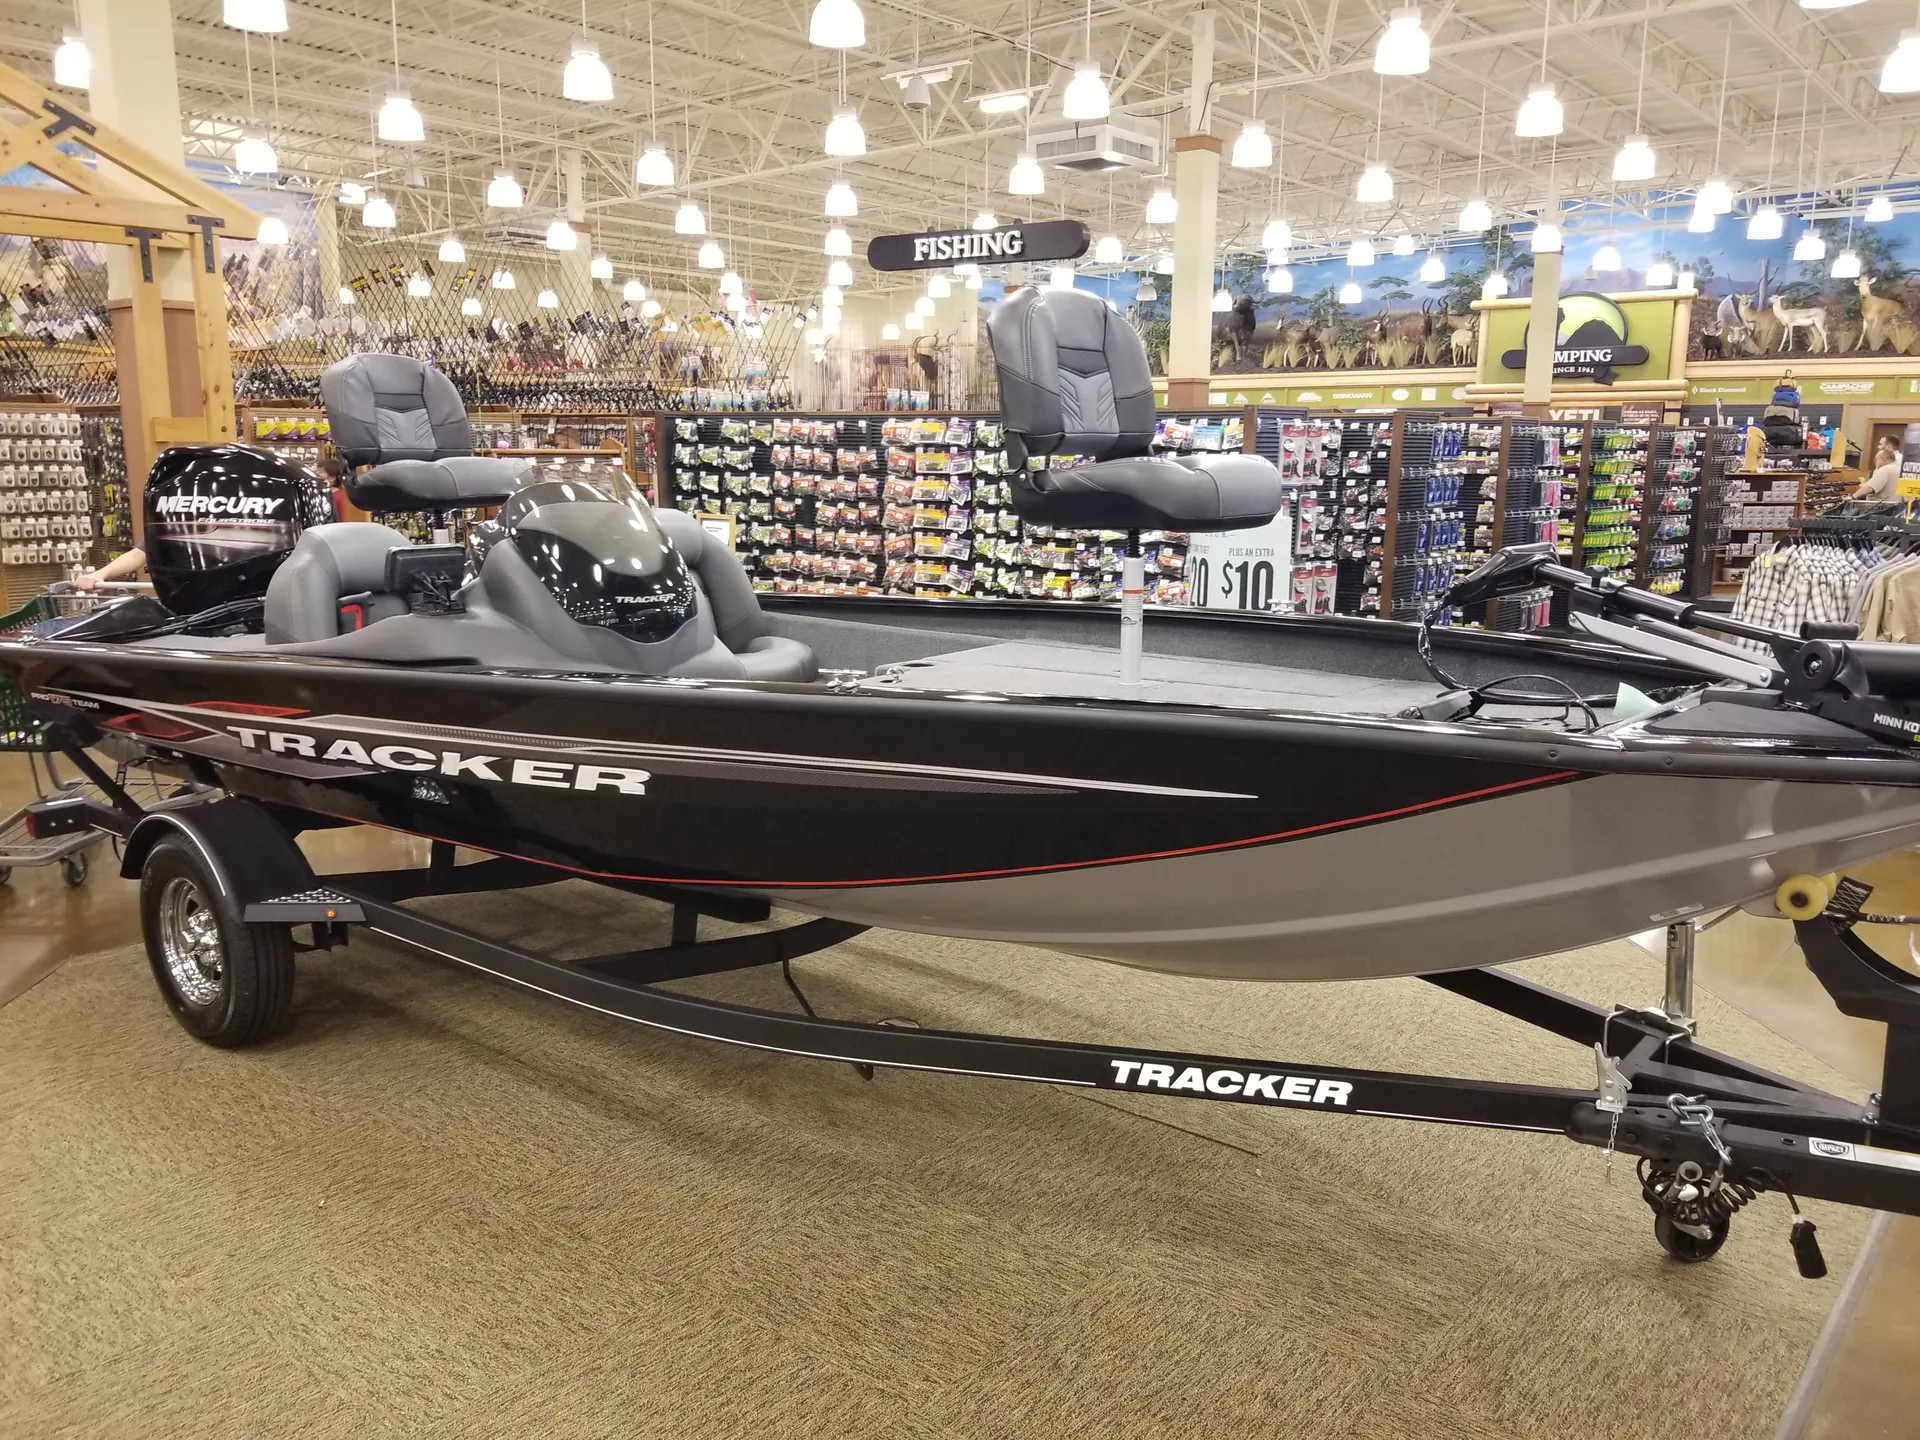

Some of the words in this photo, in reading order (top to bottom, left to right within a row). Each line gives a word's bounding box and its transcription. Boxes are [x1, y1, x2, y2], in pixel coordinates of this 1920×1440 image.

[913, 230, 1023, 262] FISHING
[1553, 349, 1613, 364] MPING
[1552, 366, 1576, 374] INCE
[1577, 366, 1595, 374] 1961
[1548, 409, 1600, 421] YETI
[156, 495, 285, 515] MERCURY
[1229, 548, 1243, 557] PLUS
[1245, 548, 1253, 557] AN
[1255, 548, 1275, 557] EXTRA
[1221, 560, 1274, 611] $10
[615, 593, 676, 604] TRACKER
[1872, 712, 1903, 729] MINN
[1903, 720, 1920, 734] KO
[226, 725, 652, 795] TRACKER
[1110, 1060, 1354, 1106] TRACKER
